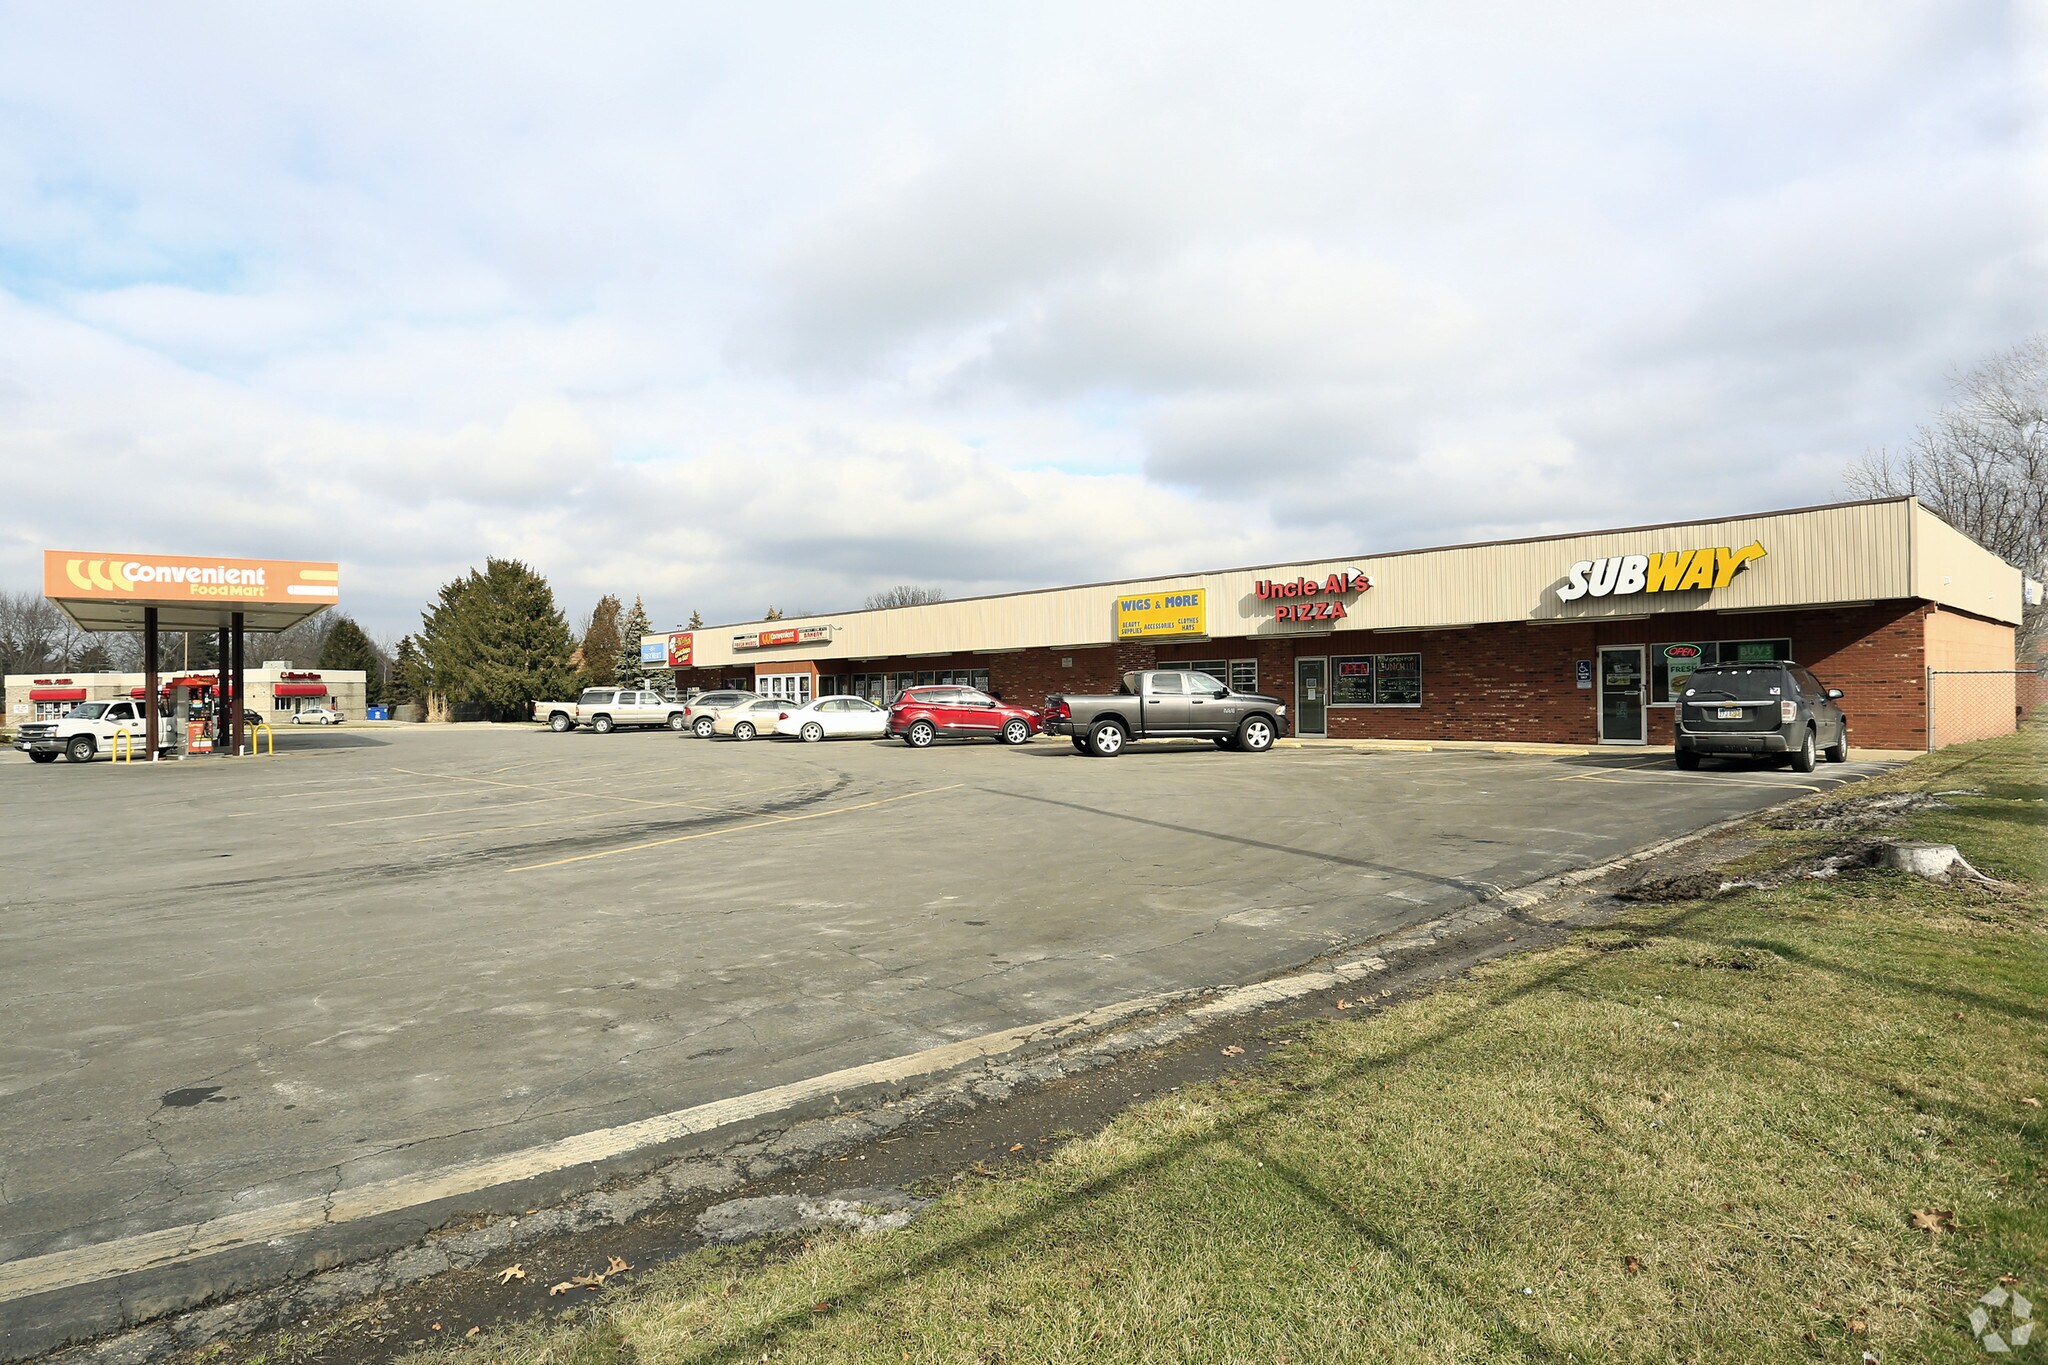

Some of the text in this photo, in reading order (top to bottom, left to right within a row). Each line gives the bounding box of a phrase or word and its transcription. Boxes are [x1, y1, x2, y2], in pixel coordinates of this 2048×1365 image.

[122, 561, 265, 585] Convenient
[1556, 540, 1767, 603] SUBWAY
[1255, 577, 1318, 600] Uncle
[1121, 594, 1198, 612] WIGS & MORE
[1275, 601, 1347, 623] PIZZA
[1144, 622, 1175, 630] ACCESSORIES
[1668, 646, 1698, 657] OPEN
[1740, 646, 1764, 656] BUY
[1670, 665, 1698, 673] FRESH
